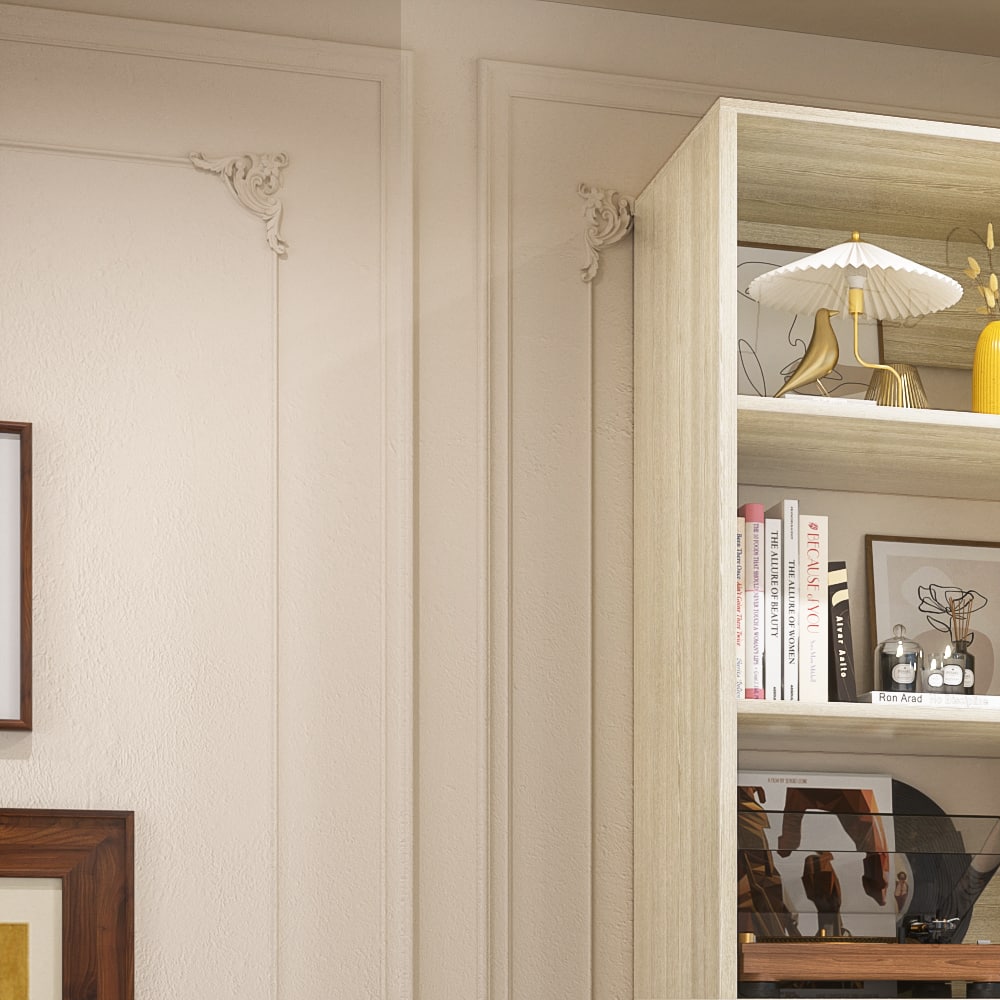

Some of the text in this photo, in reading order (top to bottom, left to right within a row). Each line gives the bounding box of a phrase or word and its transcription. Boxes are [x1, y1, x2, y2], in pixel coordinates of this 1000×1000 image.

[770, 530, 779, 638] THE ALLURE OF BEAUTY
[806, 533, 820, 591] BECAUSE
[788, 560, 796, 665] THE ALLURE OF WOMEN
[806, 602, 820, 634] YOU
[835, 615, 845, 645] Alvar
[879, 693, 897, 703] Ron
[900, 693, 923, 704] Arad
